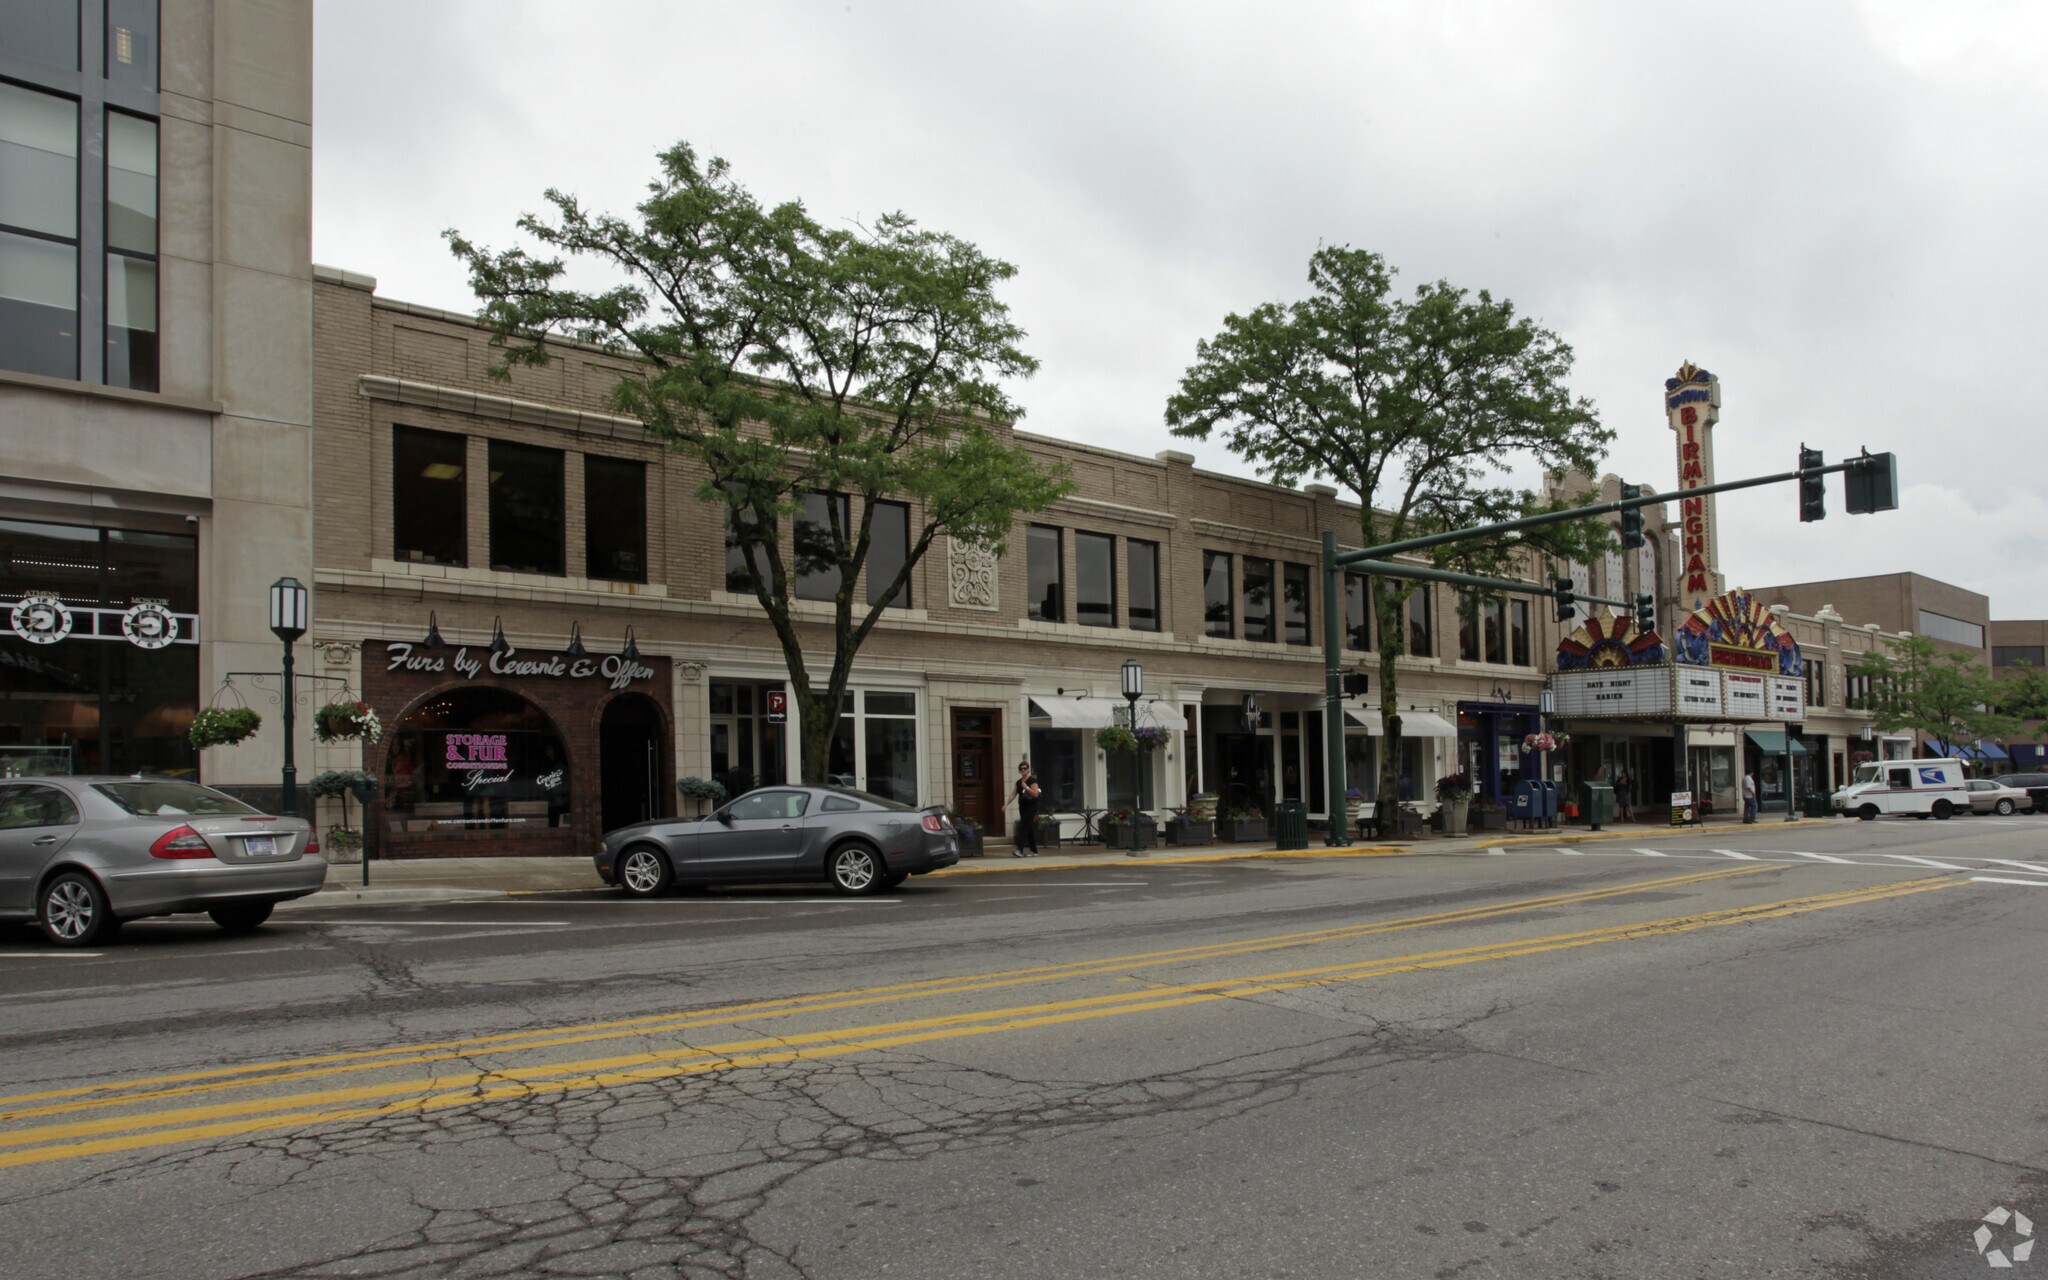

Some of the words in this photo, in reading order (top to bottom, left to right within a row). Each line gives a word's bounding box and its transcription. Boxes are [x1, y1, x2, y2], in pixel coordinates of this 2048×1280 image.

[1681, 406, 1707, 593] BIRMINGHAM
[25, 590, 60, 599] ATHENS
[131, 597, 169, 605] MOSCOW
[387, 643, 445, 671] Furs
[453, 648, 481, 679] by
[489, 647, 566, 677] Ceresnie
[569, 658, 598, 678] &
[601, 656, 654, 690] Offen
[446, 734, 507, 746] STORAGE
[446, 745, 465, 760] &
[469, 746, 507, 761] FUR
[461, 769, 514, 791] Special
